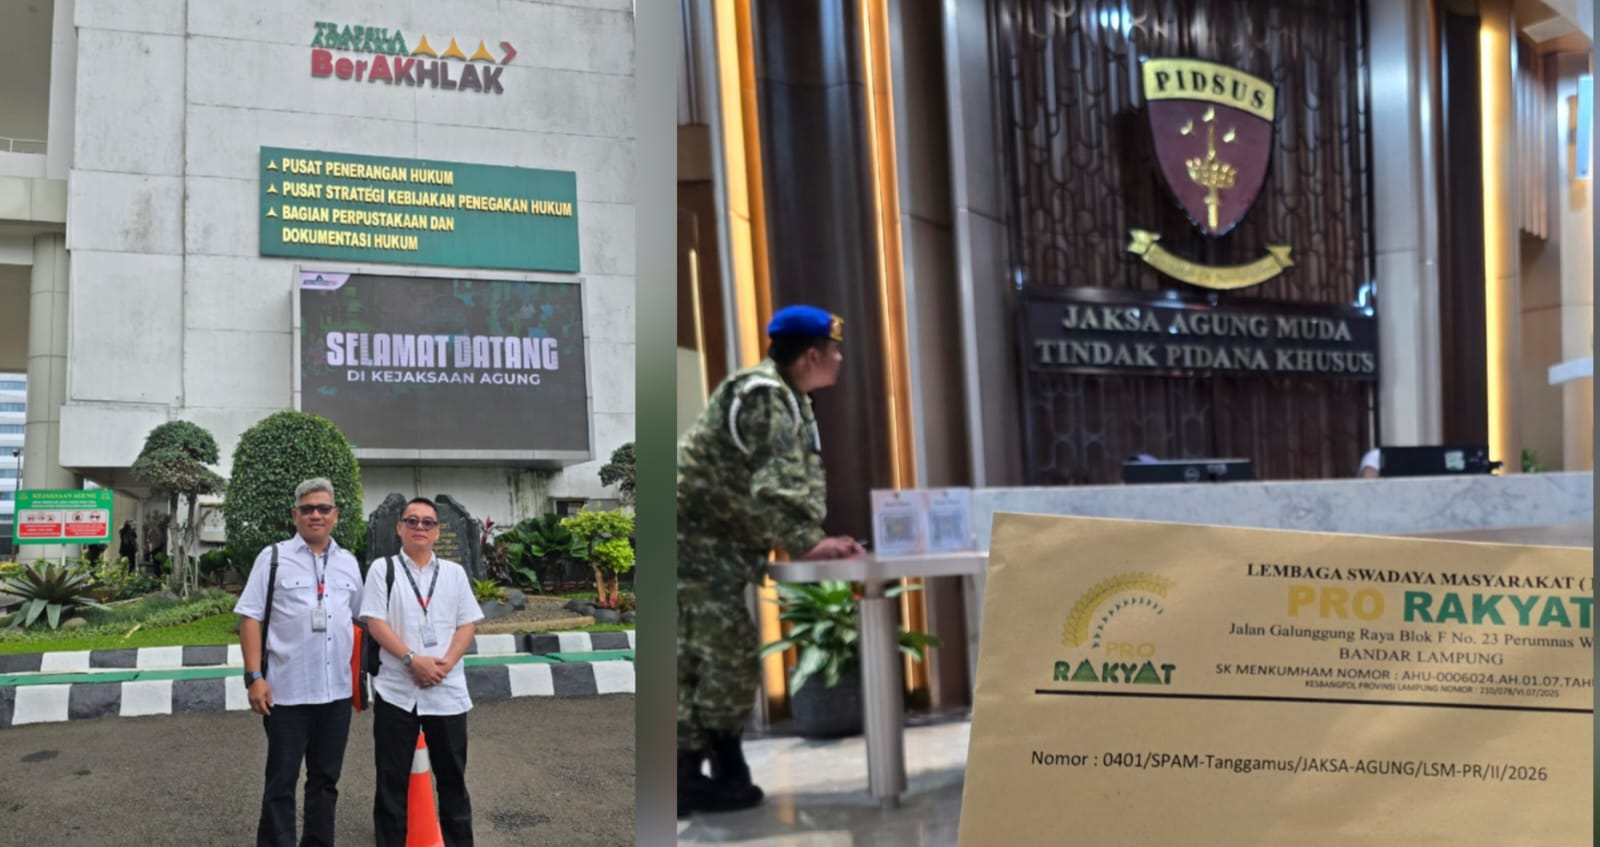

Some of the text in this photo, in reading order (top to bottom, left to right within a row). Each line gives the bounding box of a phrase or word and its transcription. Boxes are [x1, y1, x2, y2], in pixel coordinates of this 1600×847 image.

[311, 49, 504, 95] BerAKHLAK
[1154, 69, 1267, 109] PIDSUS
[282, 157, 454, 185] PUSAT PENERANGAN HUKUM
[282, 181, 572, 217] PUSAT STRATEGI KEBIJAKAN PENEGAKAN HUKUM
[282, 204, 454, 231] BAGIAN PERPUSTAKAAN DAN
[282, 227, 418, 250] DOKUMENTASI HUKUM
[1062, 305, 1351, 342] JAKSA AGUNG MUDA
[326, 331, 560, 371] SELAMAT DATANG
[1035, 339, 1376, 374] TINDAK PIDANA KHUSUS
[346, 369, 541, 386] DI KEJAKSAAN AGUNG
[1247, 563, 1343, 581] LEMBAGA
[1346, 567, 1436, 585] SWADAYA
[1440, 573, 1575, 590] MASYARAKAT
[1287, 585, 1593, 630] PRO RAKYAT
[1105, 640, 1157, 658] PRO
[1229, 622, 1266, 637] Jalan
[1269, 623, 1356, 643] Galunggung
[1359, 627, 1395, 644] Raya
[1400, 630, 1432, 642] Blok
[1437, 631, 1447, 643] F
[1451, 632, 1477, 645] No.
[1481, 632, 1499, 646] 23
[1504, 633, 1575, 649] Perumnas
[1339, 647, 1504, 666] BANDAR LAMPUNG
[1053, 657, 1177, 685] RAKYAT
[1215, 663, 1232, 675] SK
[1235, 664, 1333, 678] MENKUMHAM
[1336, 668, 1390, 680] NOMOR
[1305, 680, 1356, 690] KESBANGPOL
[1358, 682, 1396, 691] PROVINSI
[1397, 684, 1438, 693] LAMPUNG
[1440, 685, 1473, 694] NOMOR
[1031, 751, 1087, 766] Nomor
